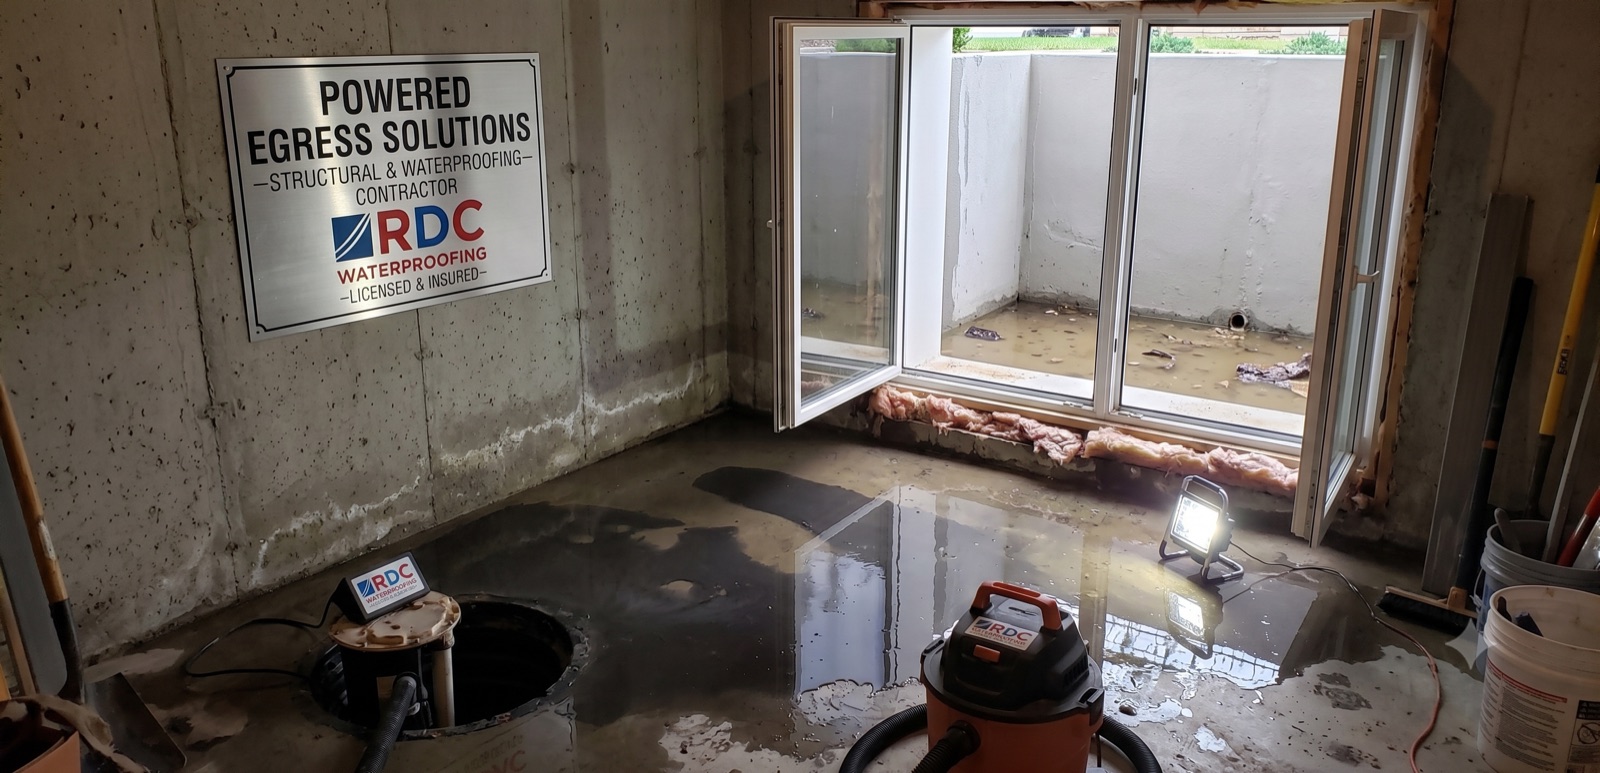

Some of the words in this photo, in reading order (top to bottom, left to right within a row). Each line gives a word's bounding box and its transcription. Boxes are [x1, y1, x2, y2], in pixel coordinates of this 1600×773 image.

[319, 76, 471, 115] POWERED
[247, 122, 373, 165] EGRESS
[383, 112, 531, 153] SOLUTIONS
[386, 161, 398, 179] &
[356, 177, 458, 206] CONTRACTOR
[377, 198, 485, 255] RDC
[336, 246, 487, 284] WATERPROOFING
[416, 276, 425, 291] &
[371, 563, 414, 592] RDC
[989, 623, 1033, 642] RDC
